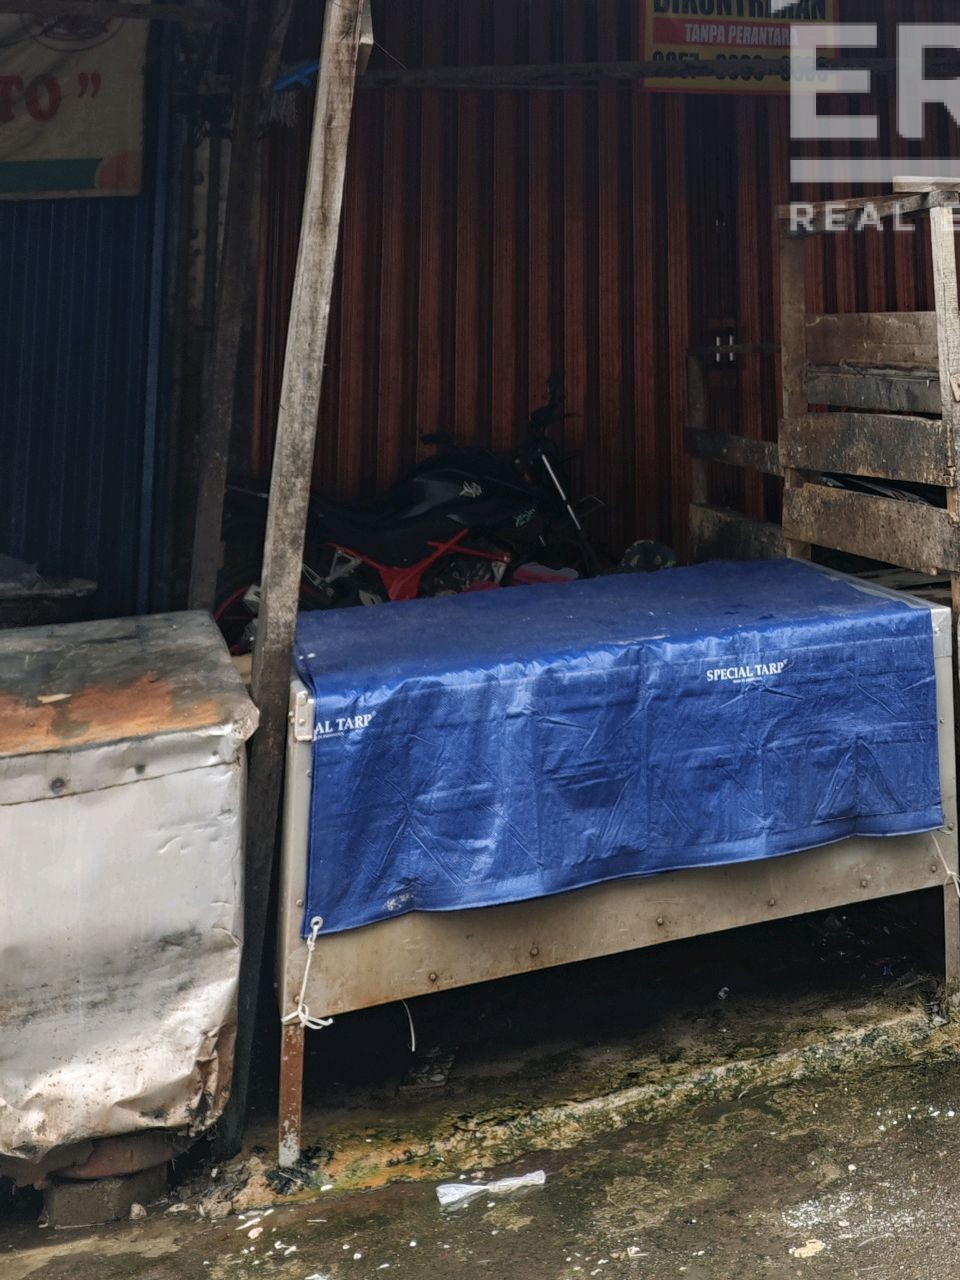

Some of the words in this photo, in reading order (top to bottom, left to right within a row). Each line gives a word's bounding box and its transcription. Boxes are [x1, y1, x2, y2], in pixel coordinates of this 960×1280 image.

[685, 23, 726, 43] TANPA
[728, 26, 799, 47] PERANTARA
[706, 665, 753, 682] SPECIAL
